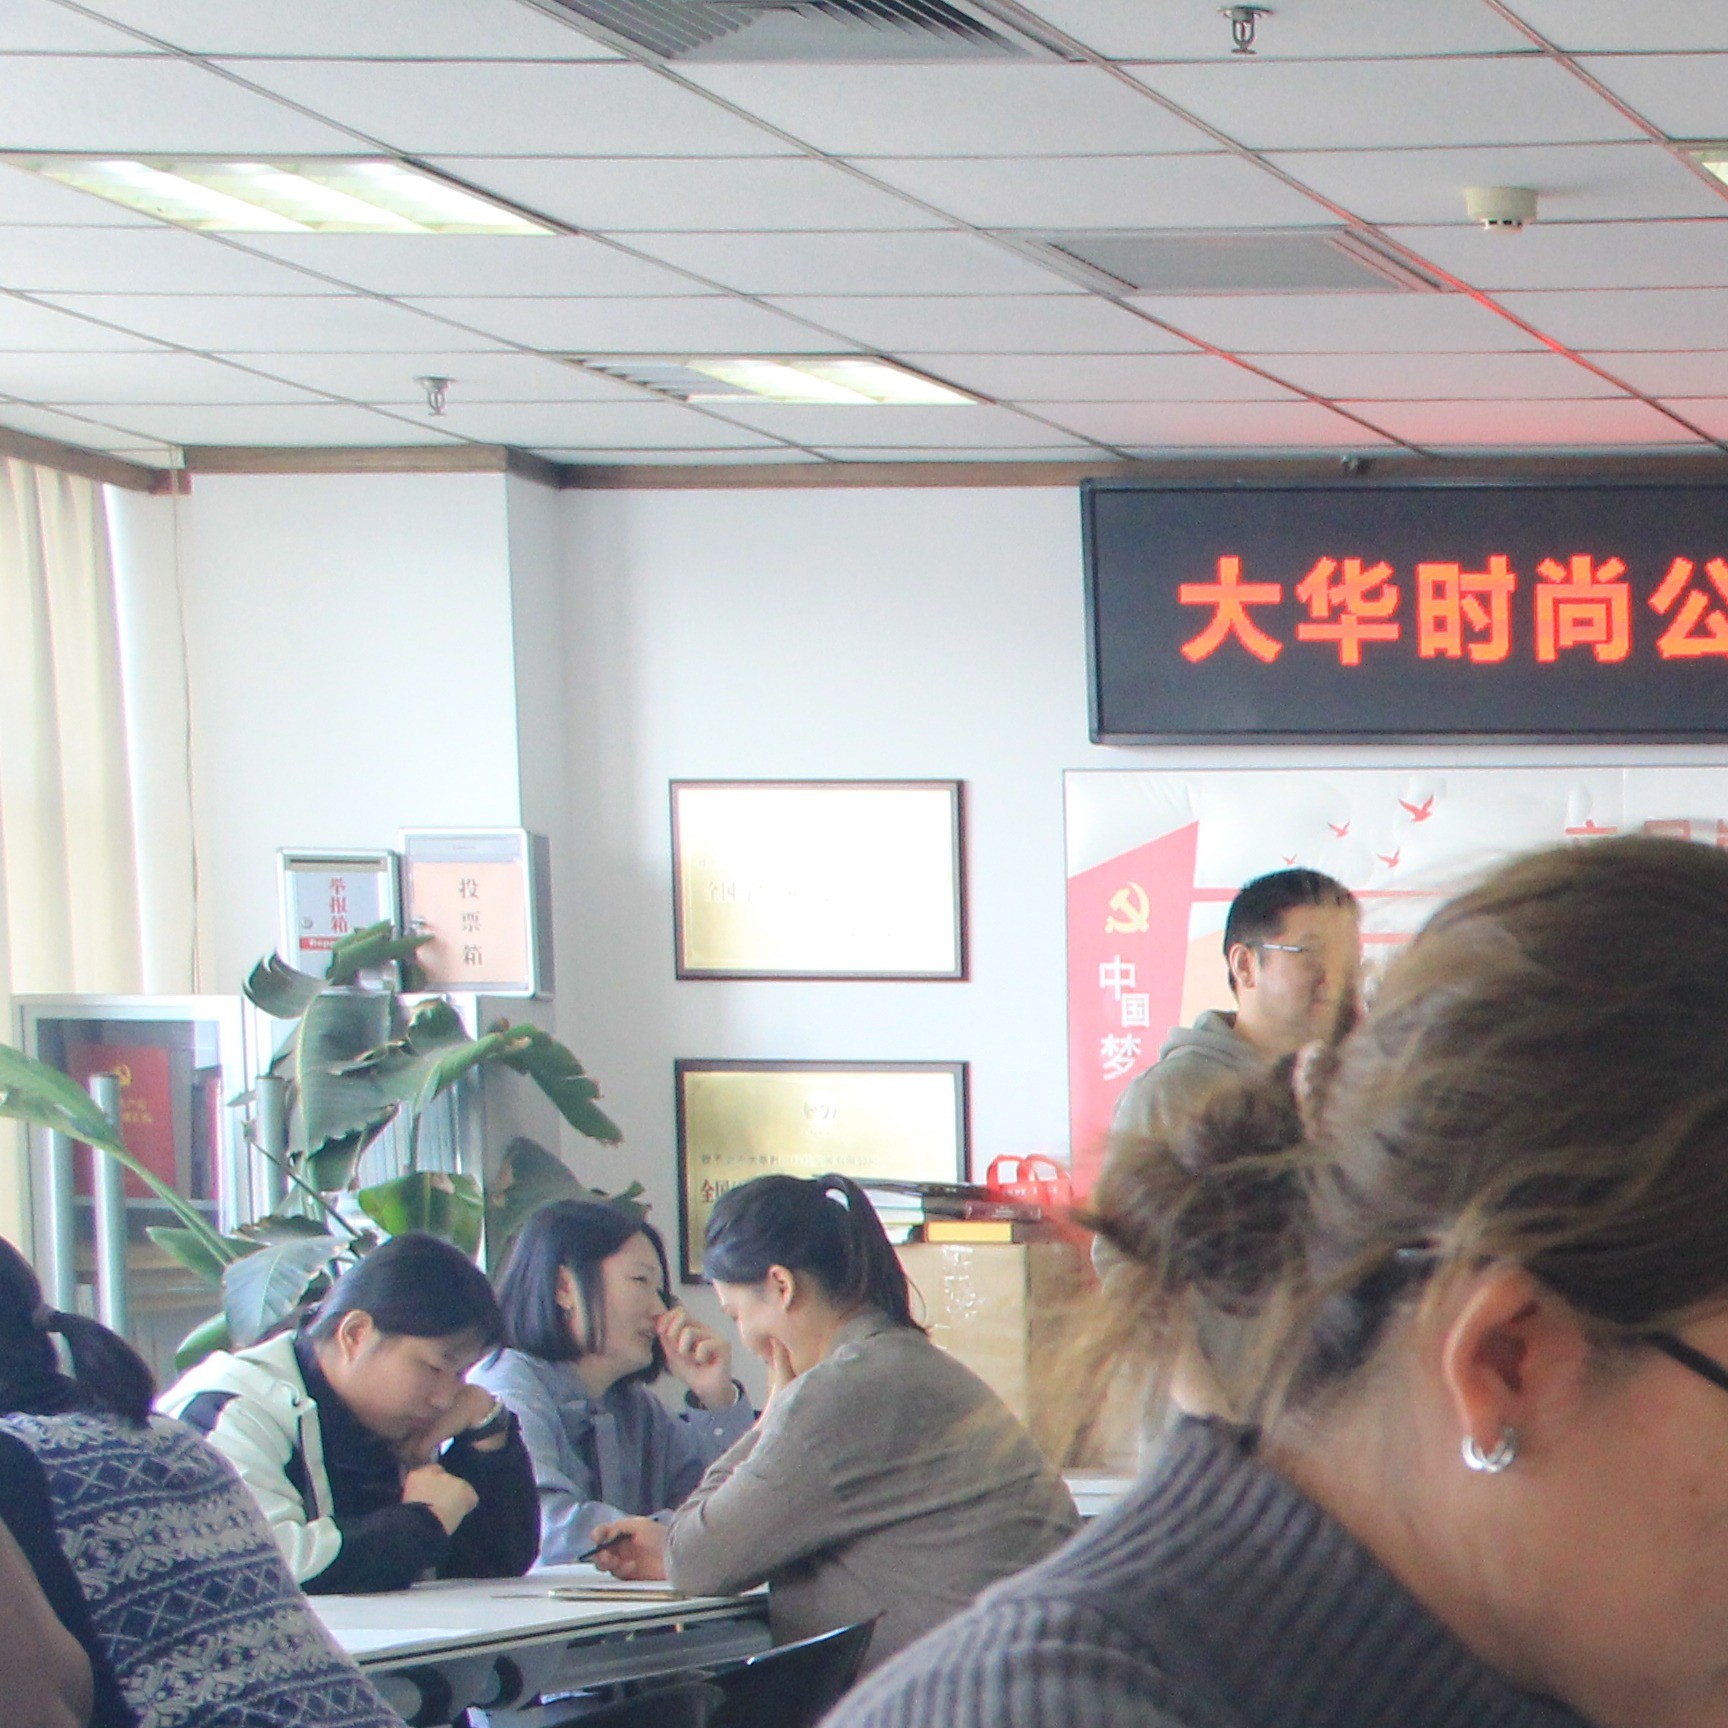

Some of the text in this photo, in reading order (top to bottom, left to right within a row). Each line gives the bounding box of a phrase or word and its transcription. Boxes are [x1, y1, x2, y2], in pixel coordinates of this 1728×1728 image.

[329, 877, 349, 934] 举报箱
[458, 877, 483, 967] 投票箱
[1098, 955, 1150, 1082] 中国梦
